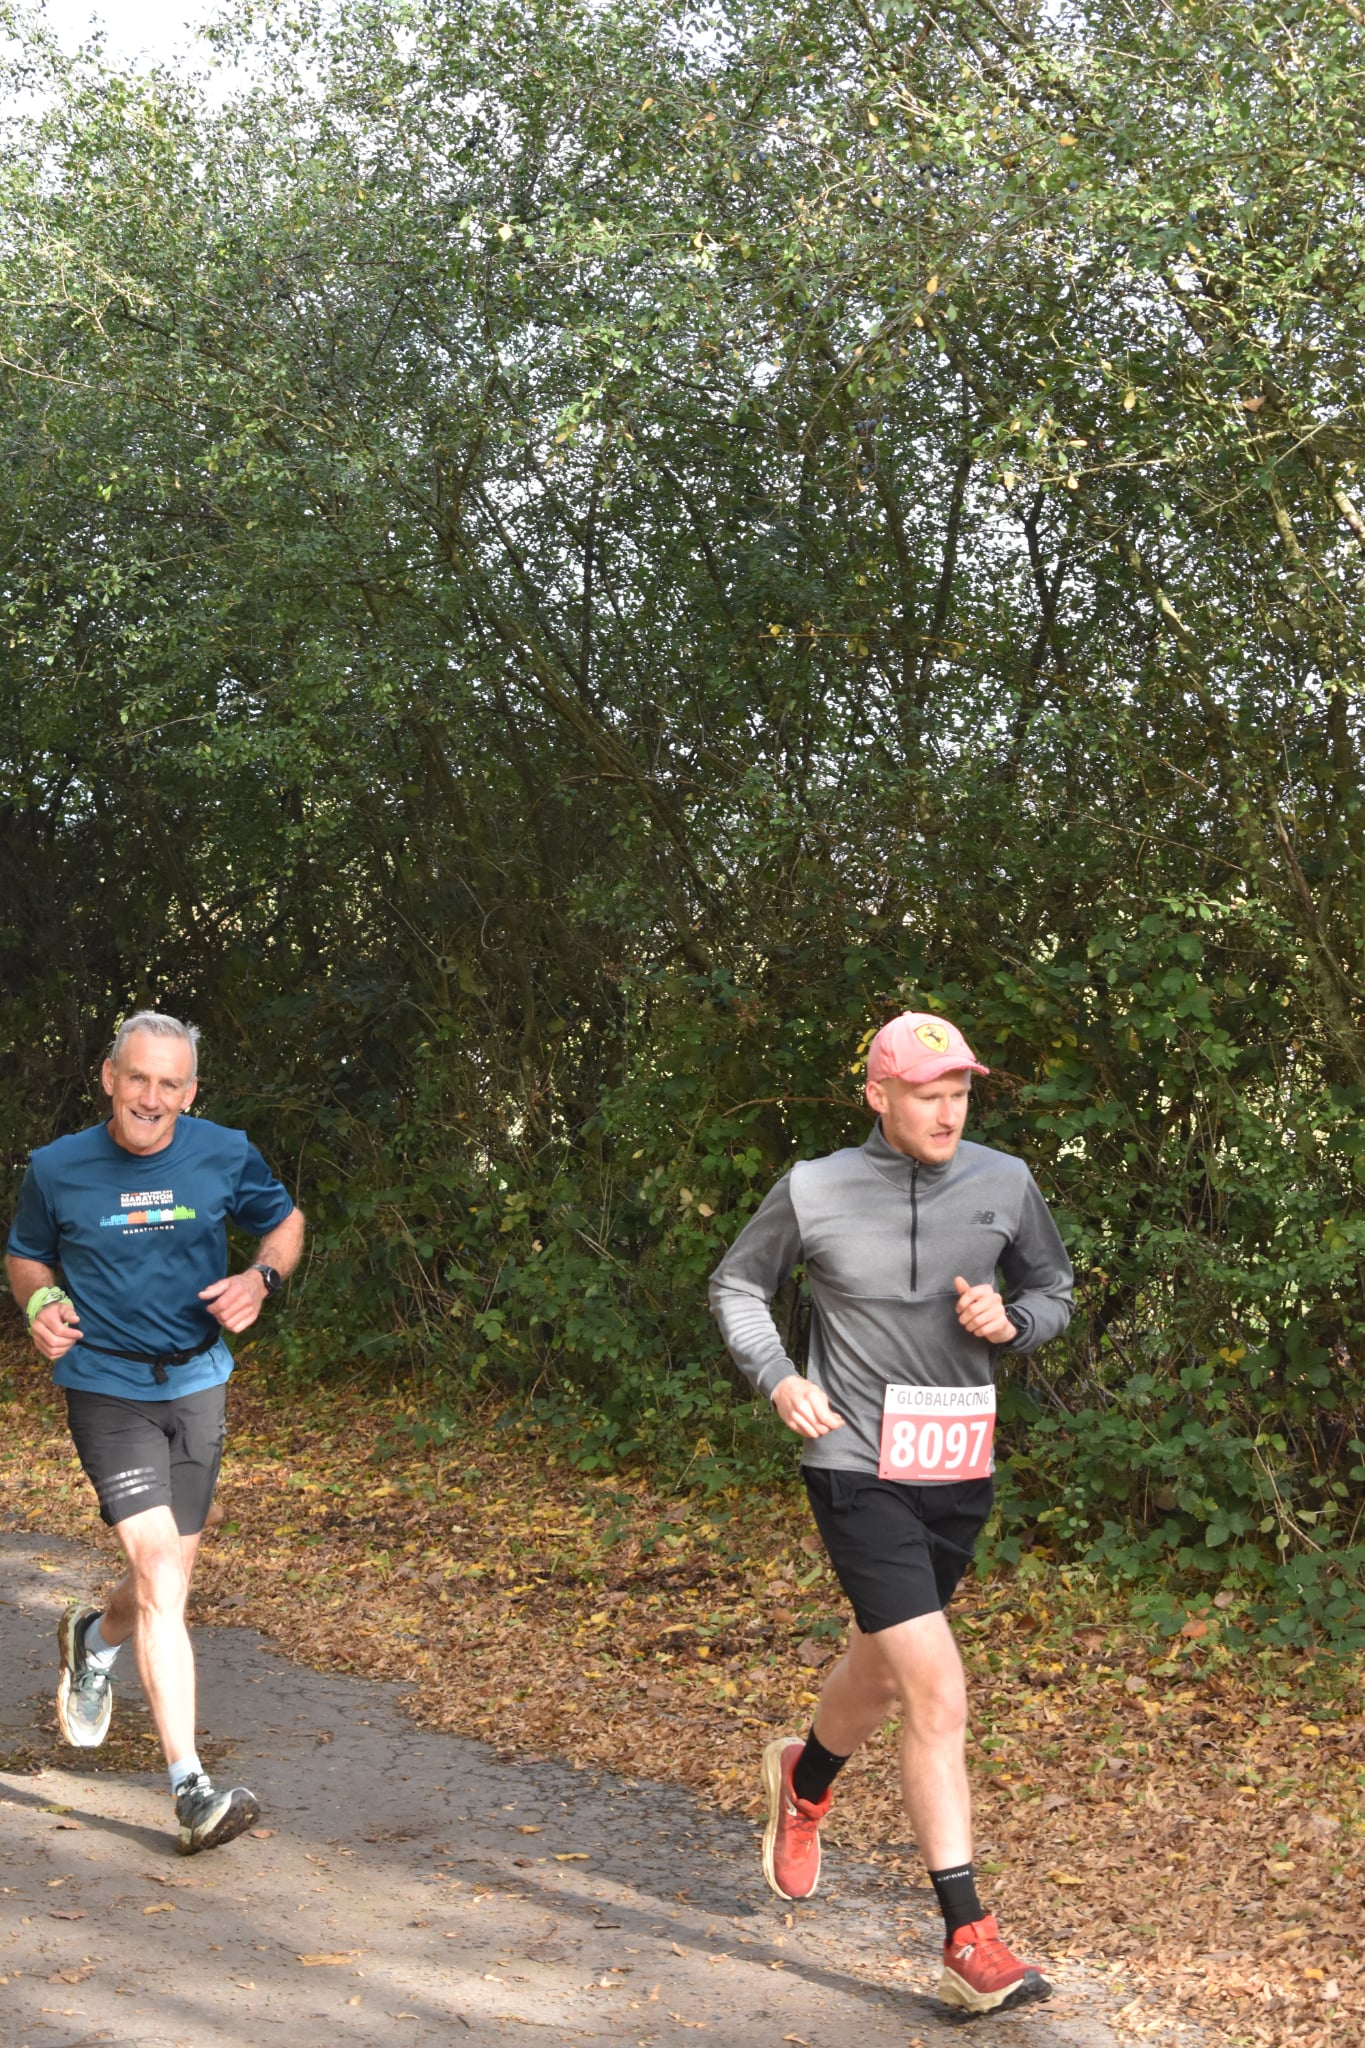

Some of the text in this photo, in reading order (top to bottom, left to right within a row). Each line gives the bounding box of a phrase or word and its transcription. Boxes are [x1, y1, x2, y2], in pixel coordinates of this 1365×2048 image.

[121, 1193, 173, 1203] MARATHON
[123, 1225, 174, 1234] MARATHONER
[897, 1390, 989, 1407] GLOBALPACING
[890, 1420, 988, 1470] 8097
